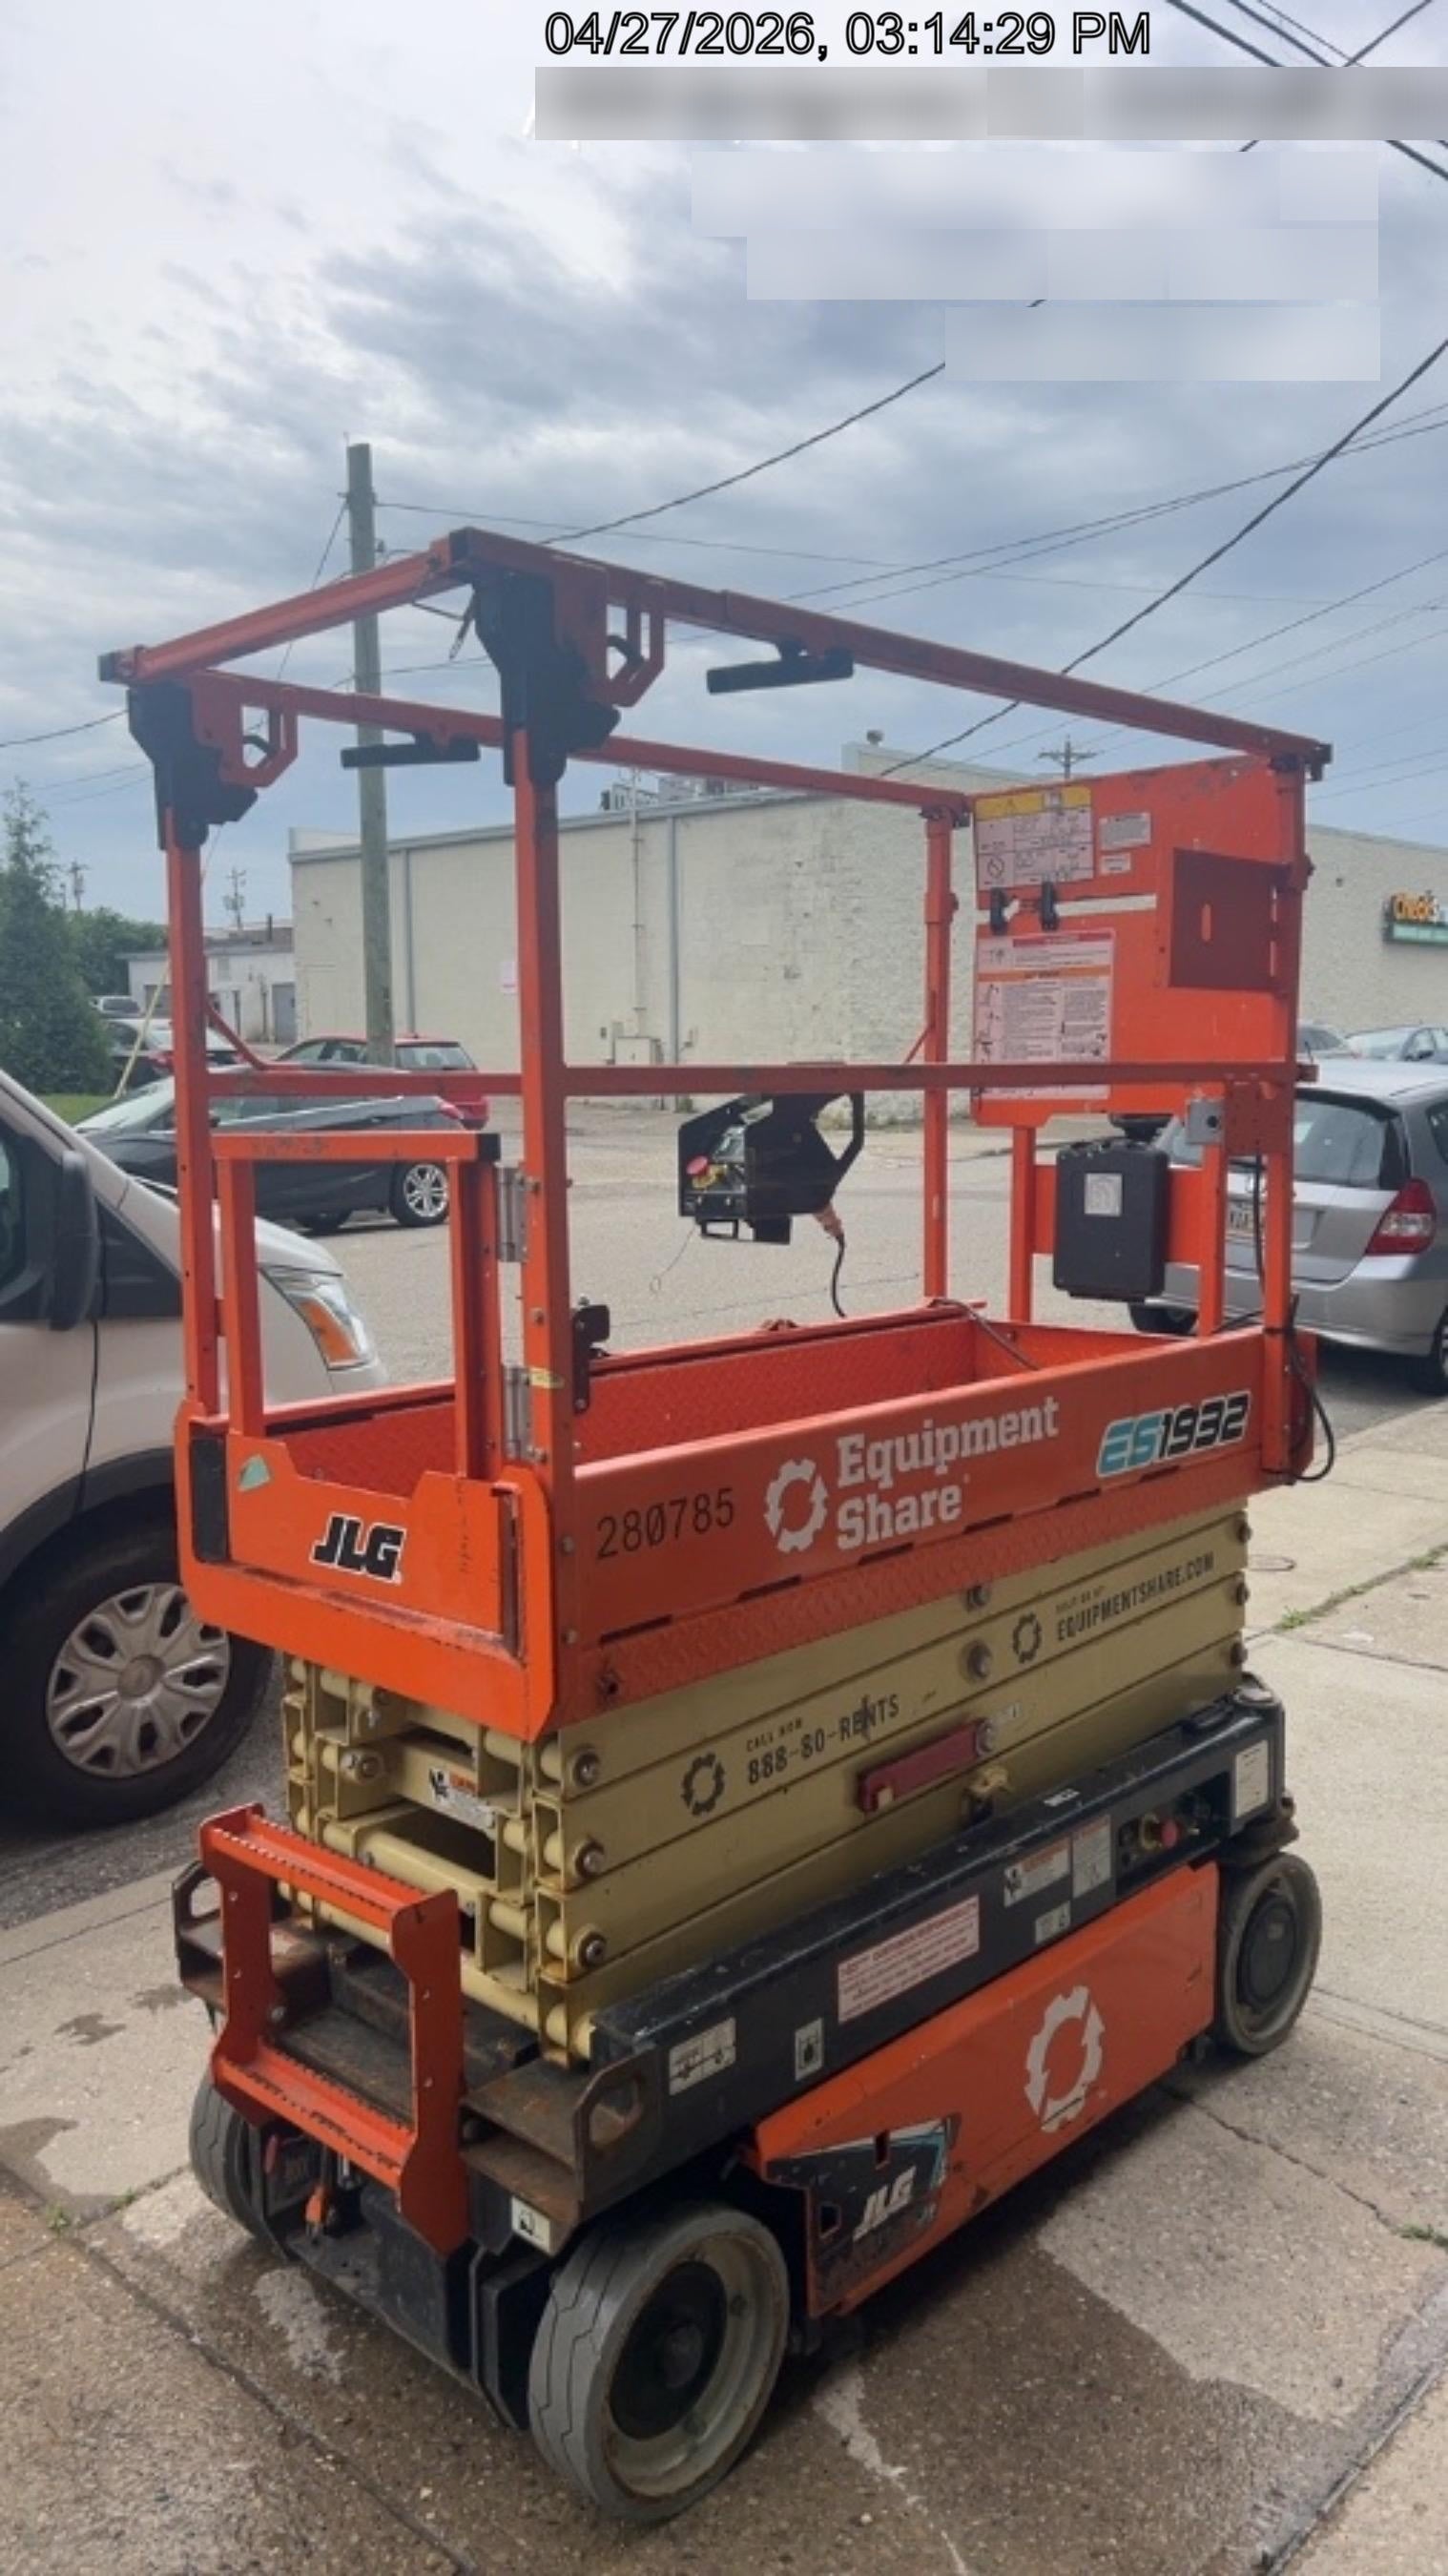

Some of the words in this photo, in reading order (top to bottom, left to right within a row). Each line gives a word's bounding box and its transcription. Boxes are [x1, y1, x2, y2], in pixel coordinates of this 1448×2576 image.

[838, 1396, 1059, 1488] Equipment
[1096, 1390, 1251, 1478] ES1932
[309, 1511, 407, 1585] JLG
[596, 1487, 734, 1560] 280785
[837, 1484, 962, 1551] Share
[1058, 1553, 1214, 1640] EQUIPMENTSHARE.COM
[748, 1693, 900, 1784] 888-80-RENTS
[854, 2166, 917, 2242] JLG
